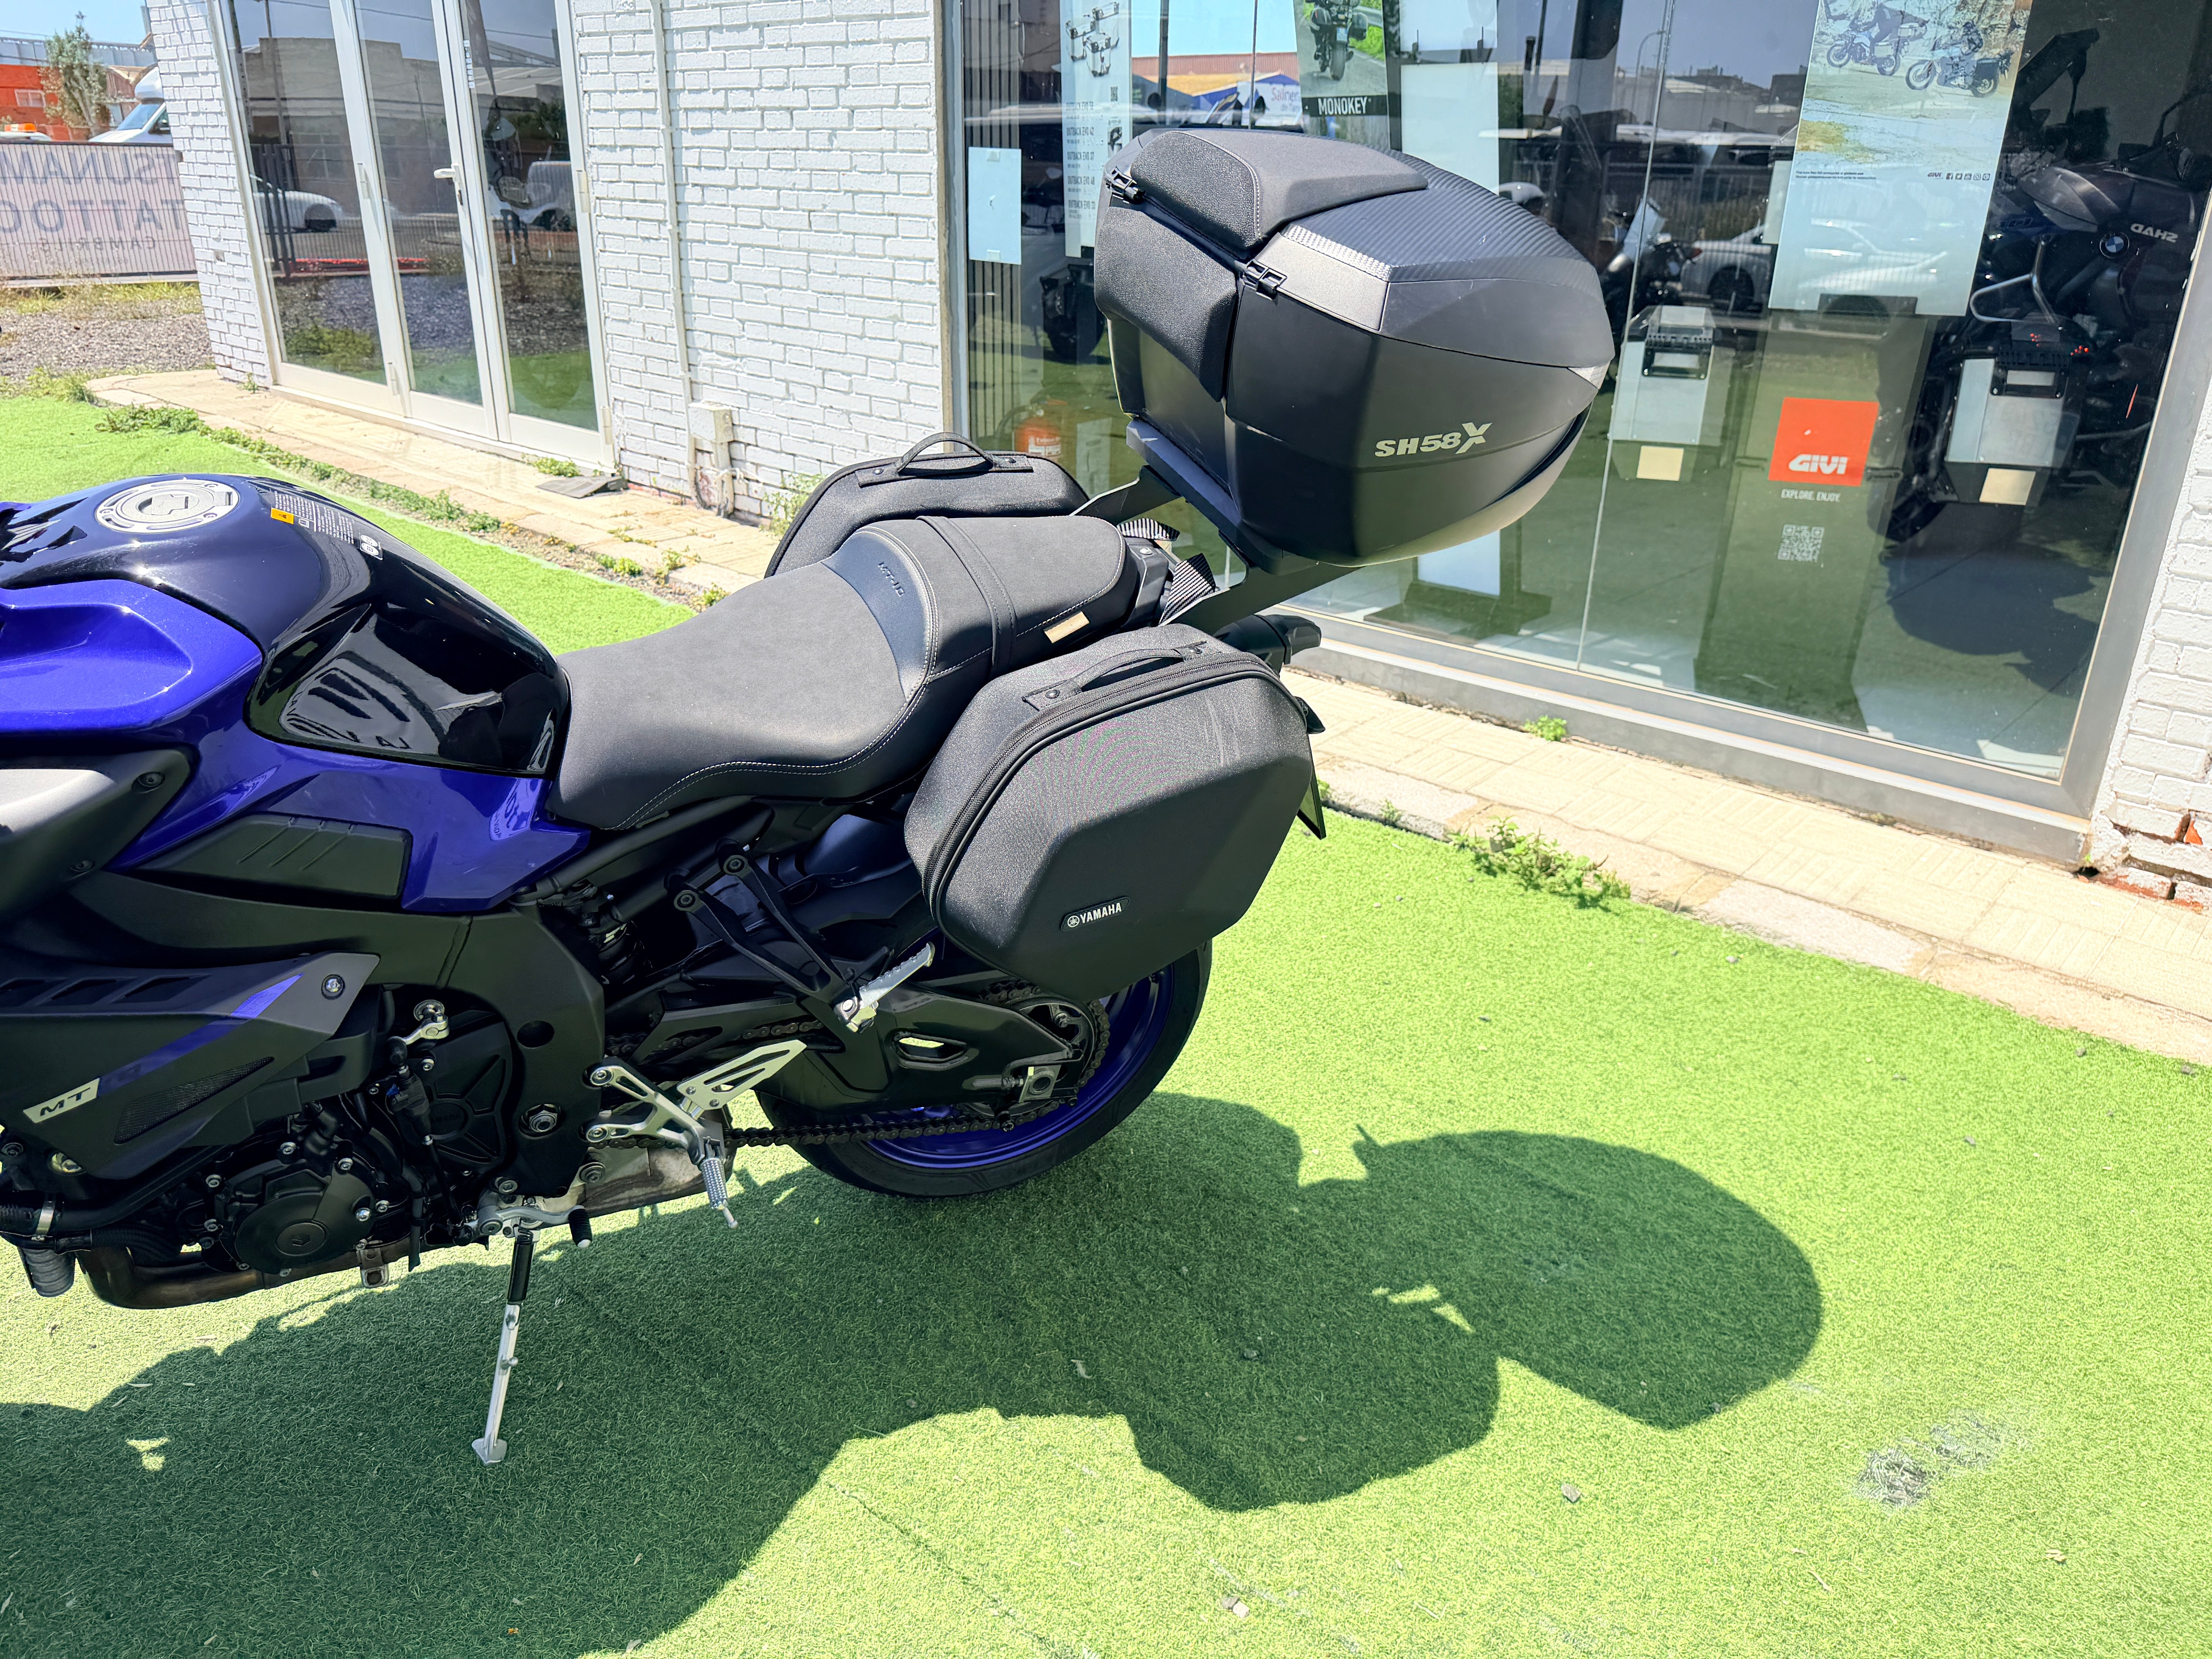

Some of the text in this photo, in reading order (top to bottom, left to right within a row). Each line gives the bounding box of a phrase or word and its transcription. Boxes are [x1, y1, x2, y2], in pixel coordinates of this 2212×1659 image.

[1318, 96, 1368, 115] MONOKEY
[1375, 422, 1492, 457] SH58X
[1788, 453, 1849, 474] GIVI
[878, 562, 905, 597] MT-10
[1080, 902, 1122, 924] YAMAHA
[40, 1087, 91, 1116] MT
